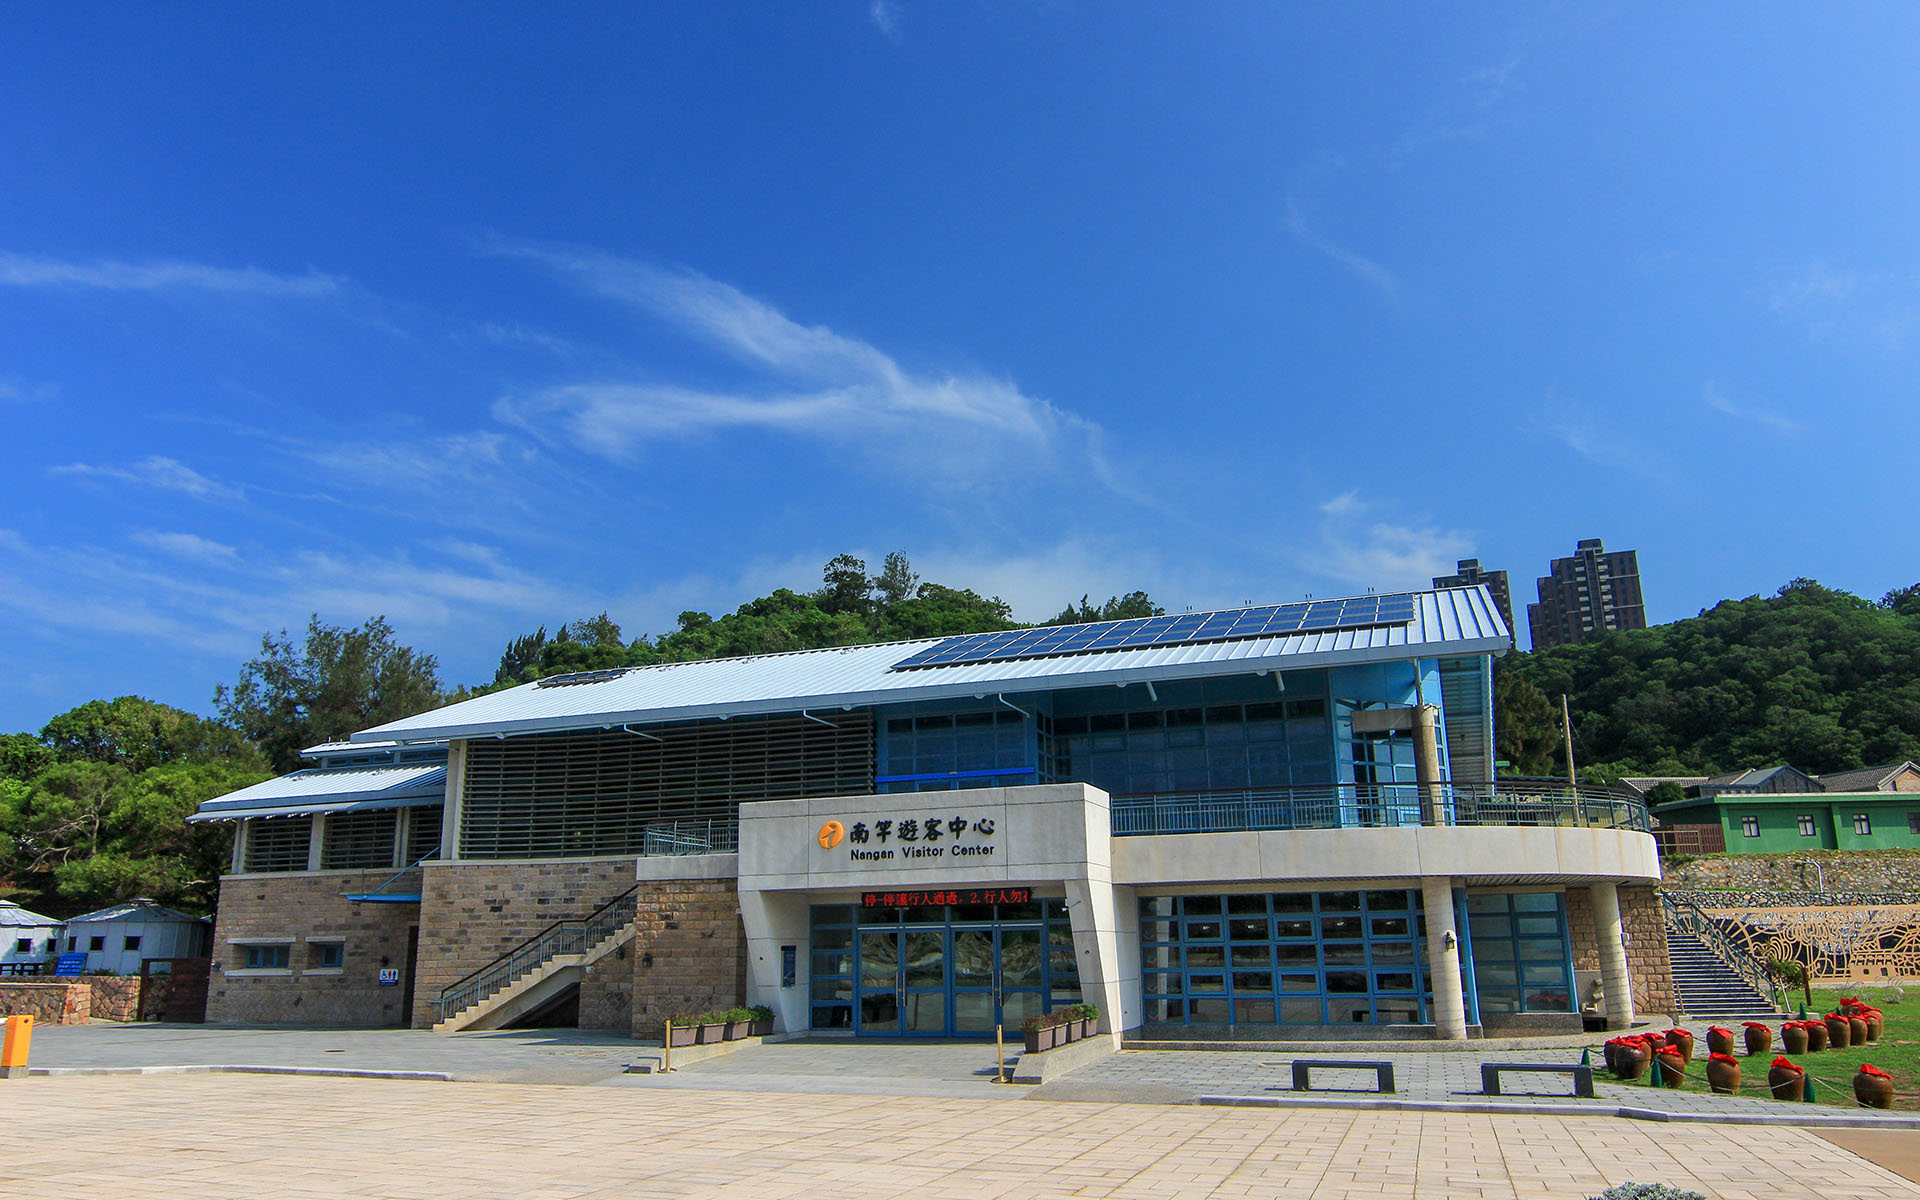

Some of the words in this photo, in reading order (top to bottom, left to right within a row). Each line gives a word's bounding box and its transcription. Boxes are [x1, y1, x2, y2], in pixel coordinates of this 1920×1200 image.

[850, 815, 995, 844] 南竿遊客中心
[850, 848, 894, 861] Nangan
[902, 846, 944, 858] Visitor
[951, 844, 995, 857] Center
